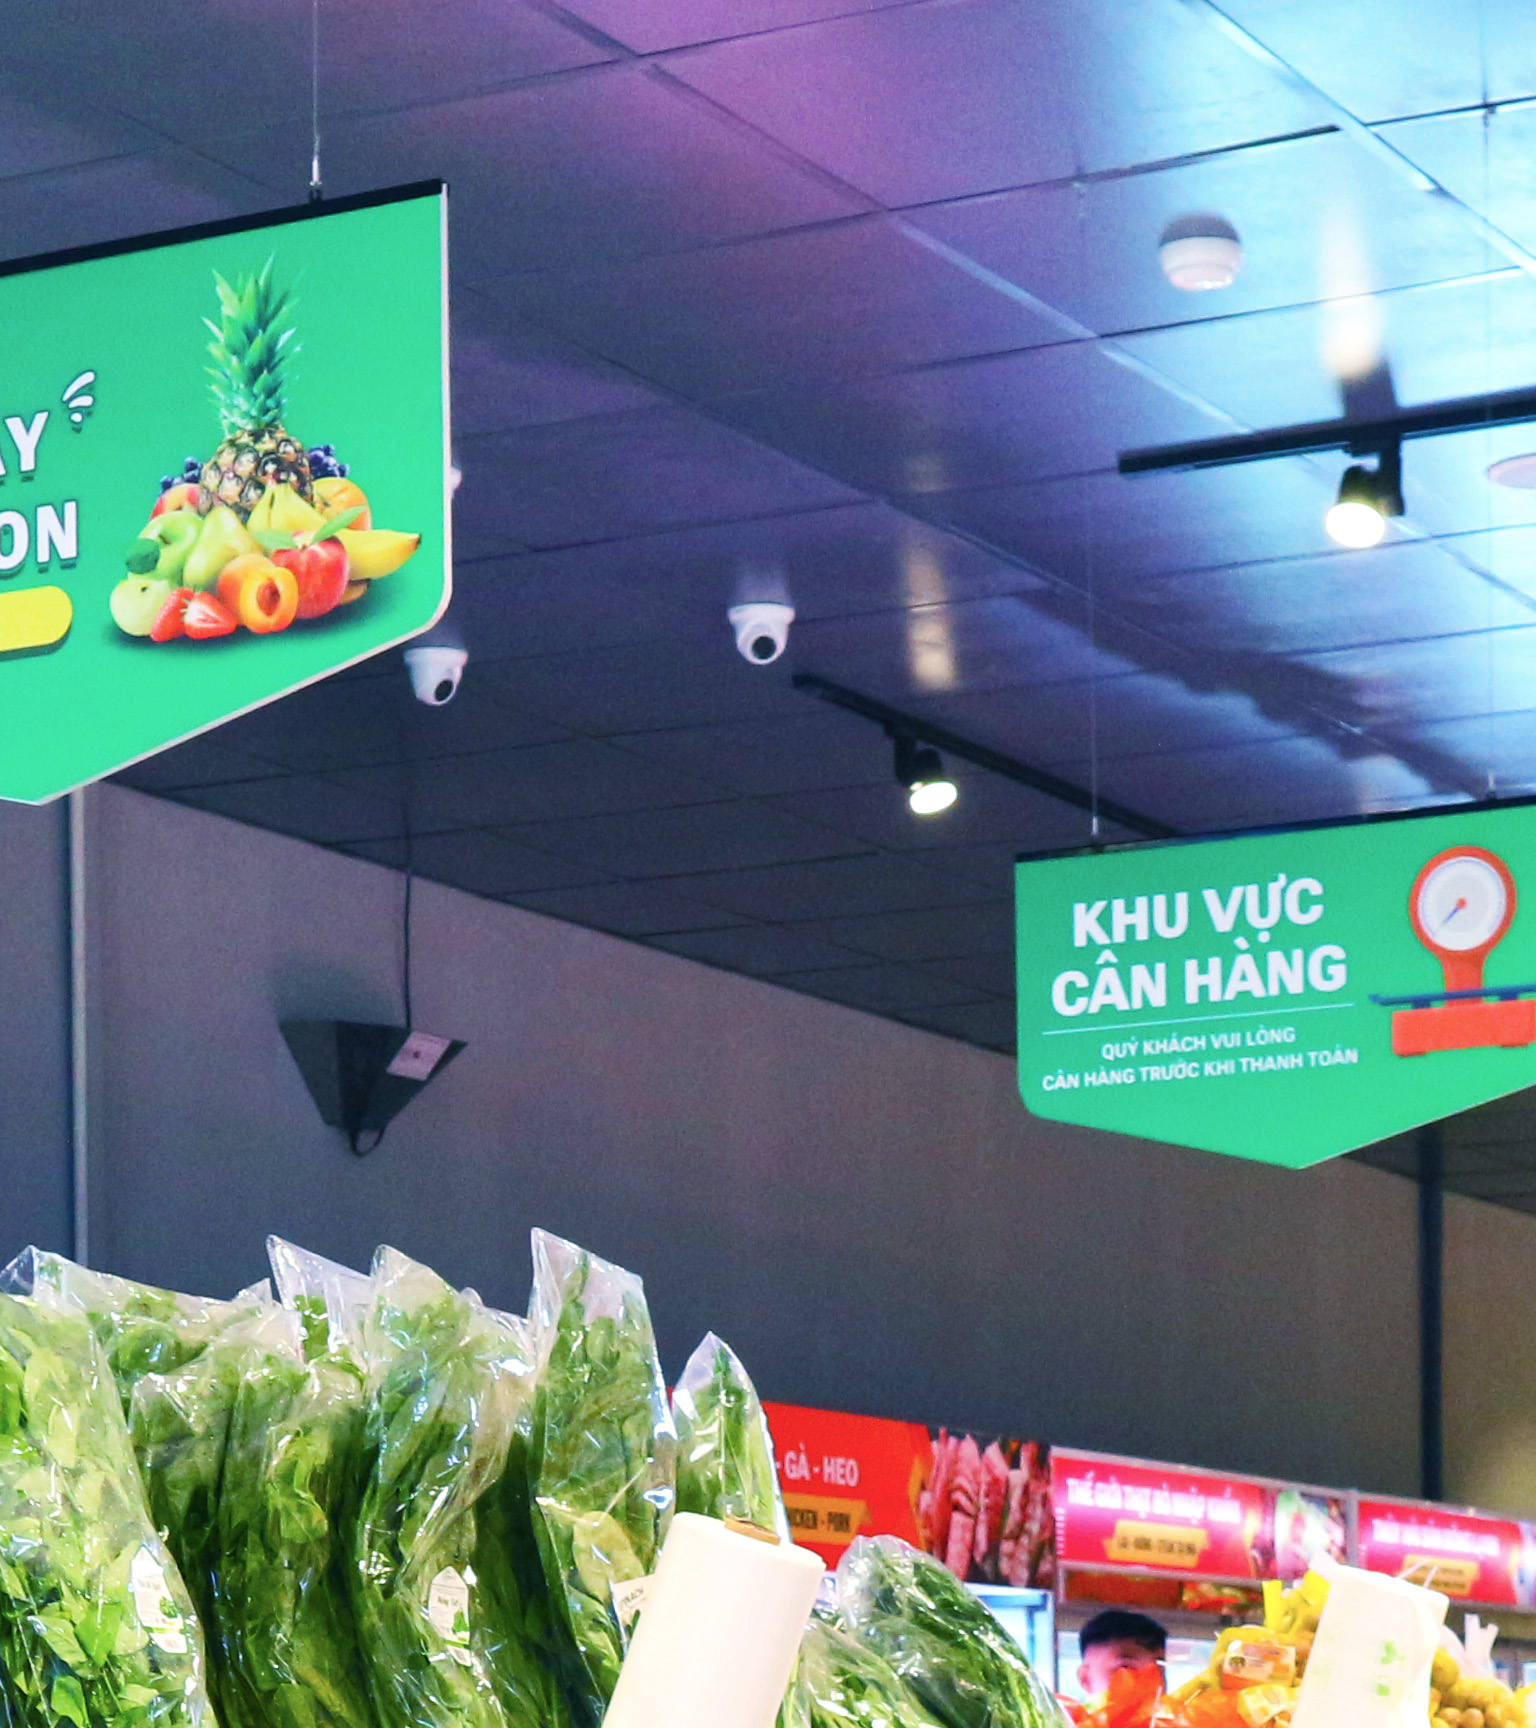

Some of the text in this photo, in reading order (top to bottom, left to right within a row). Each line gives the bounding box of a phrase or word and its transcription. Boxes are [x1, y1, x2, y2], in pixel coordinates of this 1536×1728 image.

[1071, 872, 1325, 948] KHU VỰC
[1051, 936, 1347, 1017] CÂN HÀNG
[1042, 1043, 1359, 1091] CÂN HÀNG TRƯỚC KHI THANH TOÁN
[1101, 1025, 1296, 1061] QUÝ KHÁCH VUI LÒNG
[784, 1441, 811, 1480] GÀ
[822, 1456, 860, 1488] HEO
